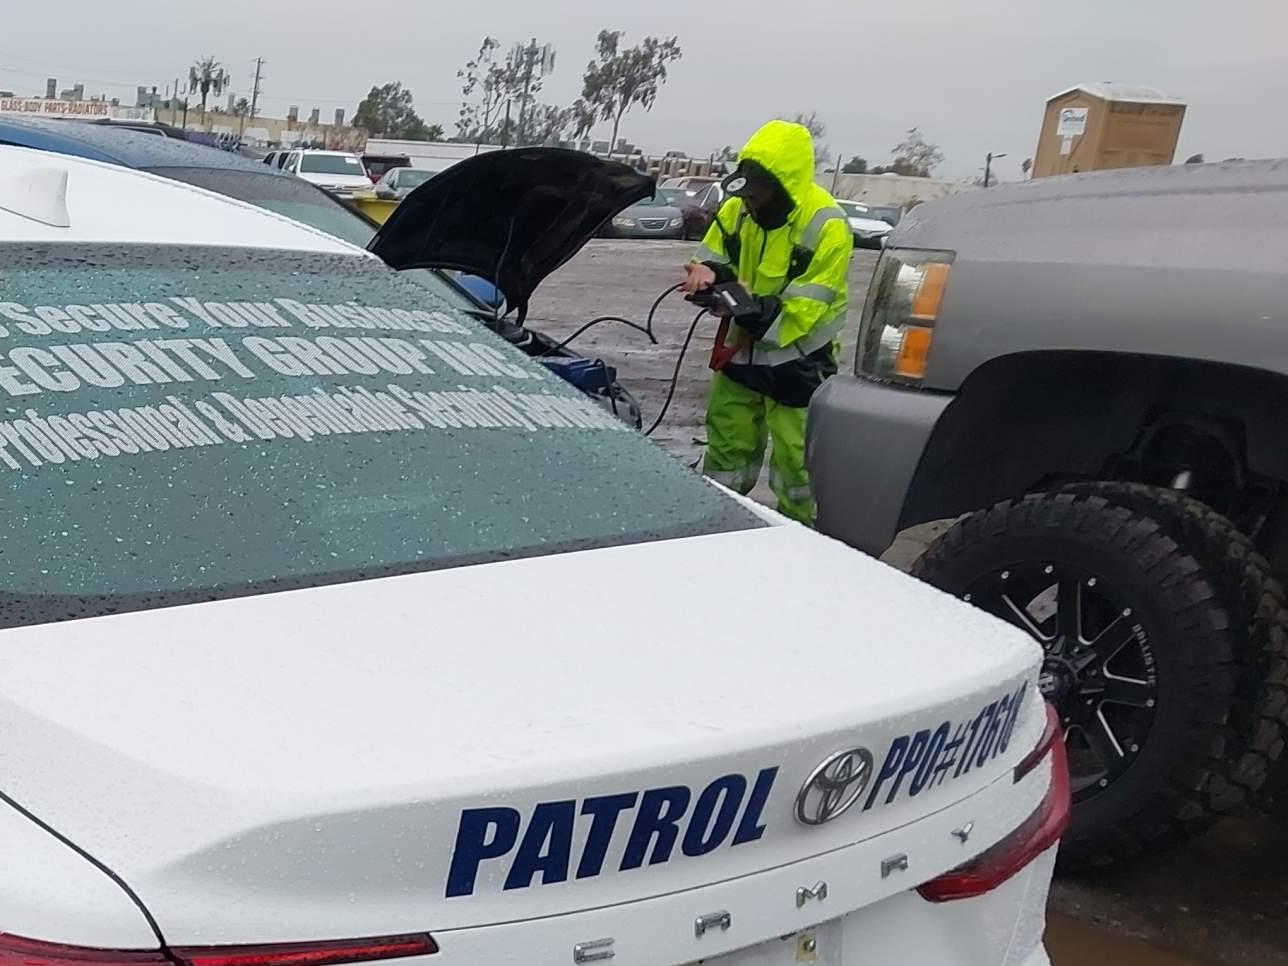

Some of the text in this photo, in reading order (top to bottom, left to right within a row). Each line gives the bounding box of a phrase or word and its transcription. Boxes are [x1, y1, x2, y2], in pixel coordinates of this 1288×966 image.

[168, 297, 293, 328] Your
[273, 297, 473, 335] Business
[242, 335, 436, 376] GROUP
[418, 339, 545, 381] INC.
[195, 400, 255, 443] &
[444, 766, 780, 898] PATROL
[573, 819, 975, 966] CAMRY
